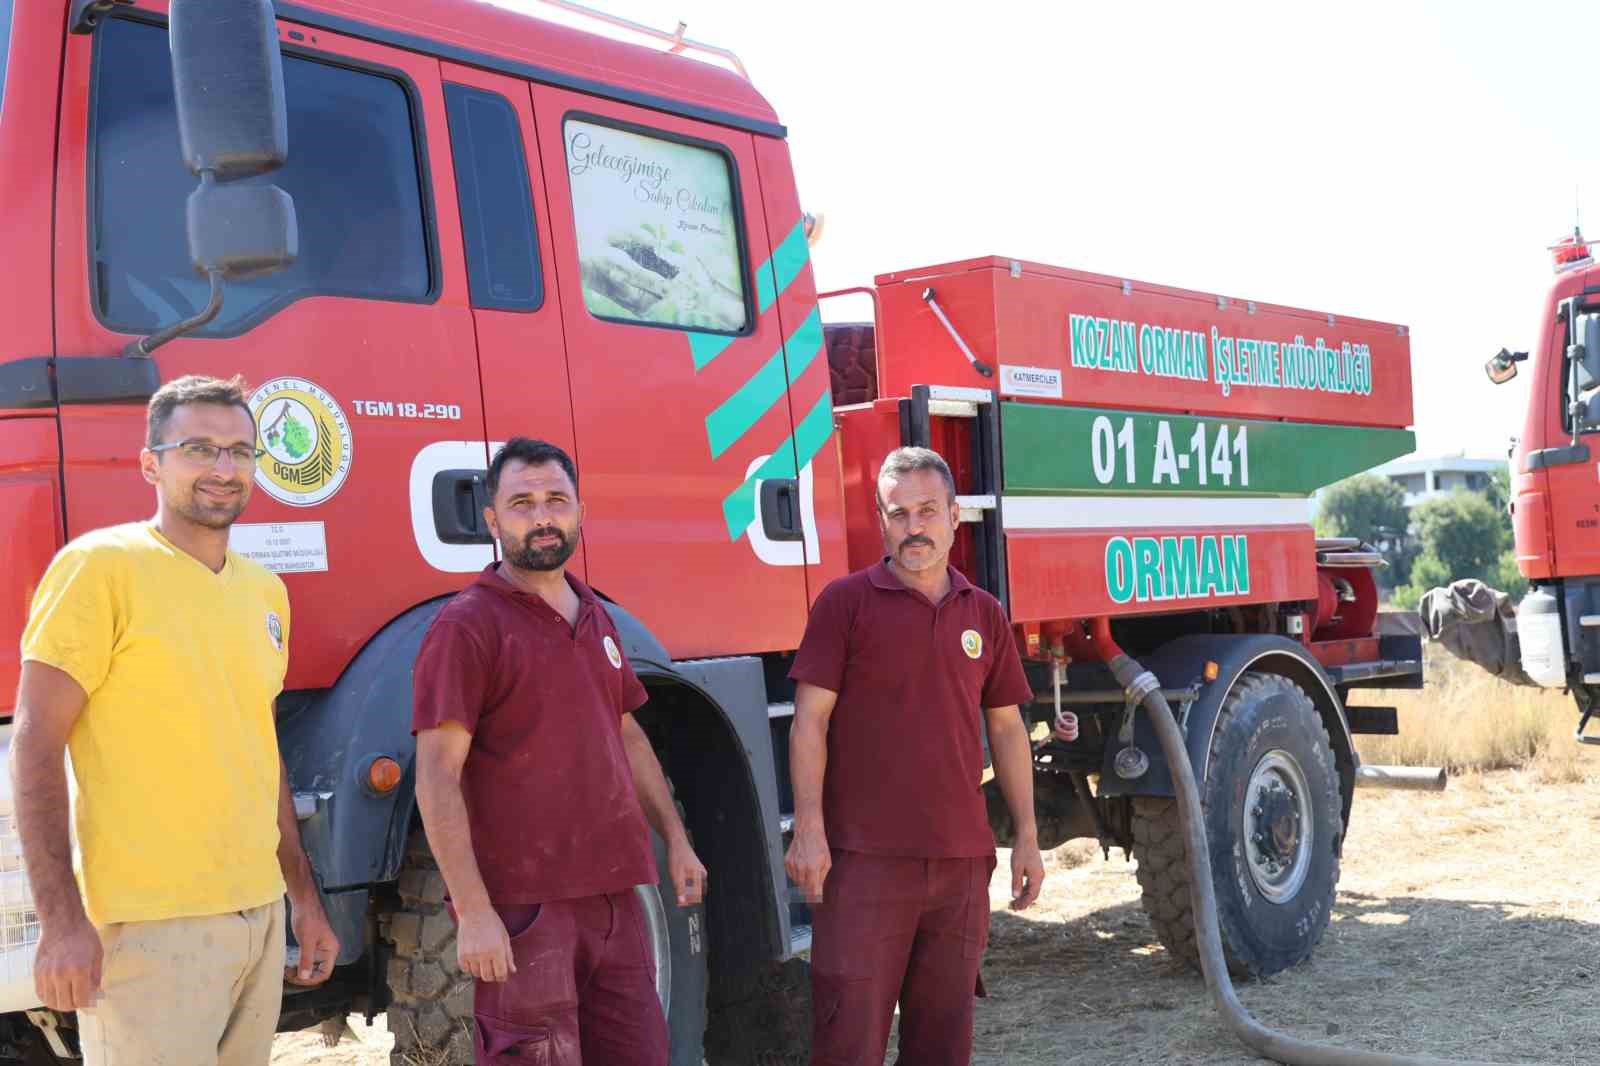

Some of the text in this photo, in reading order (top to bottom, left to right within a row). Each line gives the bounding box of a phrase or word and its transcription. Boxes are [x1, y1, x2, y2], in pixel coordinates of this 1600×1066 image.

[570, 132, 672, 188] Geleceğimize
[1069, 313, 1373, 397] KOZAN ORMAN İŞLETME MÜDÜRLÜĞÜ
[352, 400, 462, 420] TGM 18.290
[273, 462, 300, 485] OGM
[1091, 415, 1249, 486] 01 A-141
[1104, 534, 1250, 603] ORMAN
